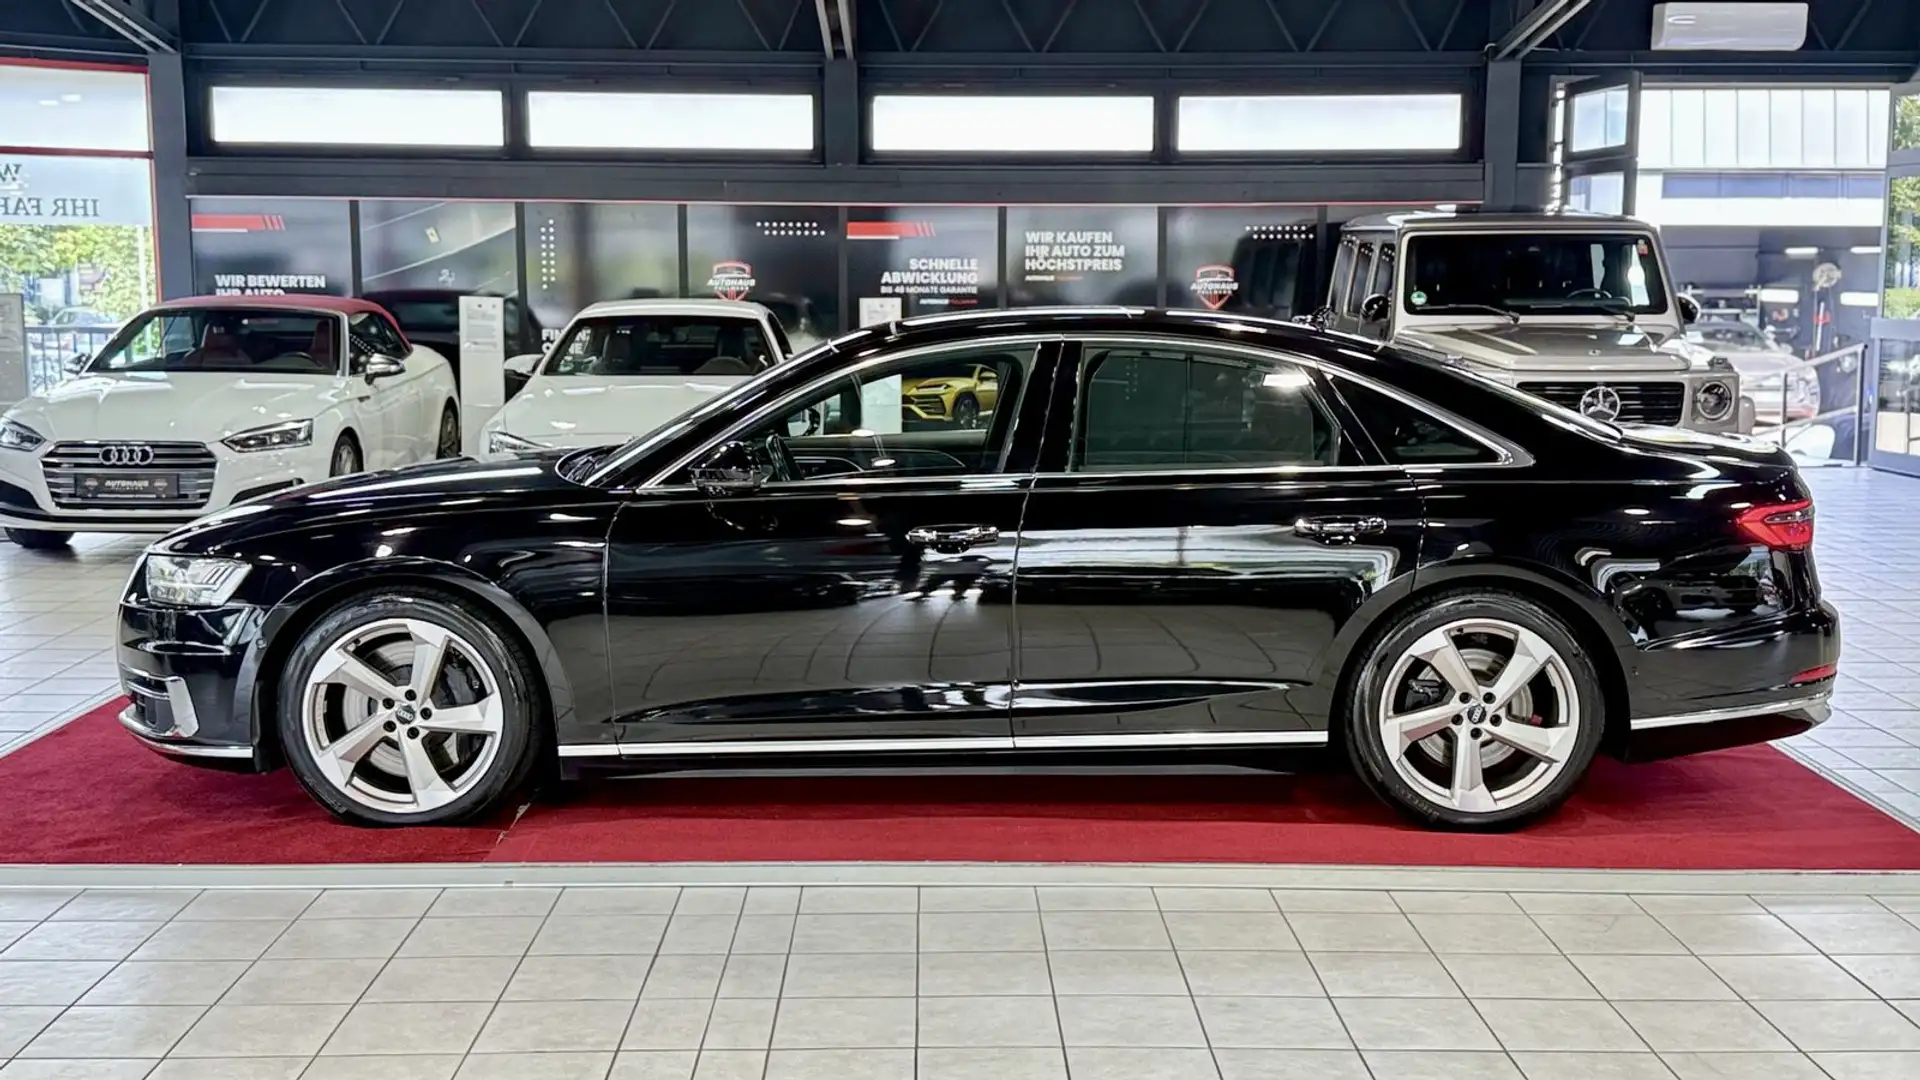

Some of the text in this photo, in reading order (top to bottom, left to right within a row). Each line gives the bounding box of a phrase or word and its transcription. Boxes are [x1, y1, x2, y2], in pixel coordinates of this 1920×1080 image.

[1025, 231, 1113, 244] WIR KAUFEN
[1025, 245, 1125, 257] IHR AUTO ZUM
[909, 258, 978, 270] SCHNELLE
[214, 274, 326, 288] WIR BEWERTEN
[880, 271, 978, 284] ABWICKLUNG
